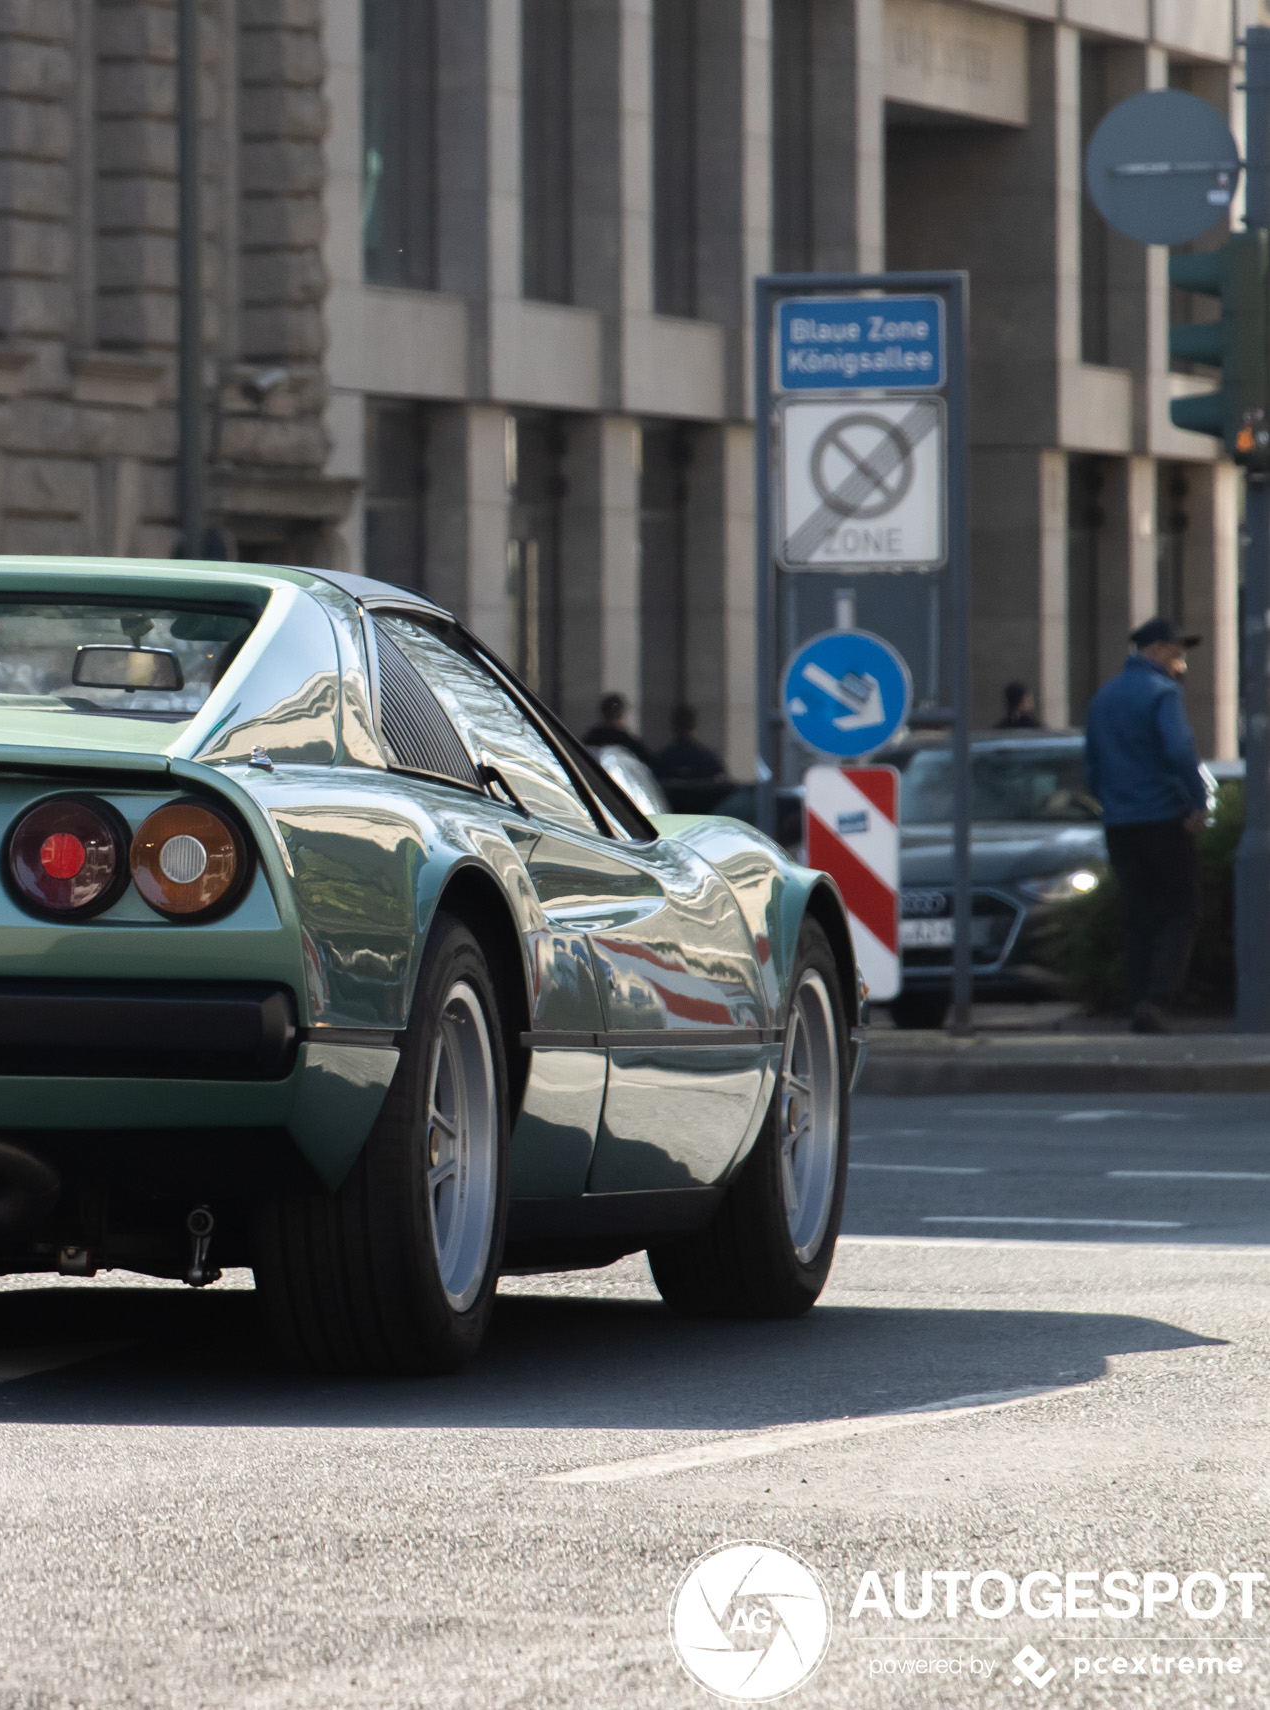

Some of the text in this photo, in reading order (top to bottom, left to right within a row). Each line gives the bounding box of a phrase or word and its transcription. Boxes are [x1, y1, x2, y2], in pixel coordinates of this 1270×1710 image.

[790, 315, 930, 343] Blaue Zone
[787, 346, 933, 378] Königsallee
[824, 527, 903, 555] ZONE
